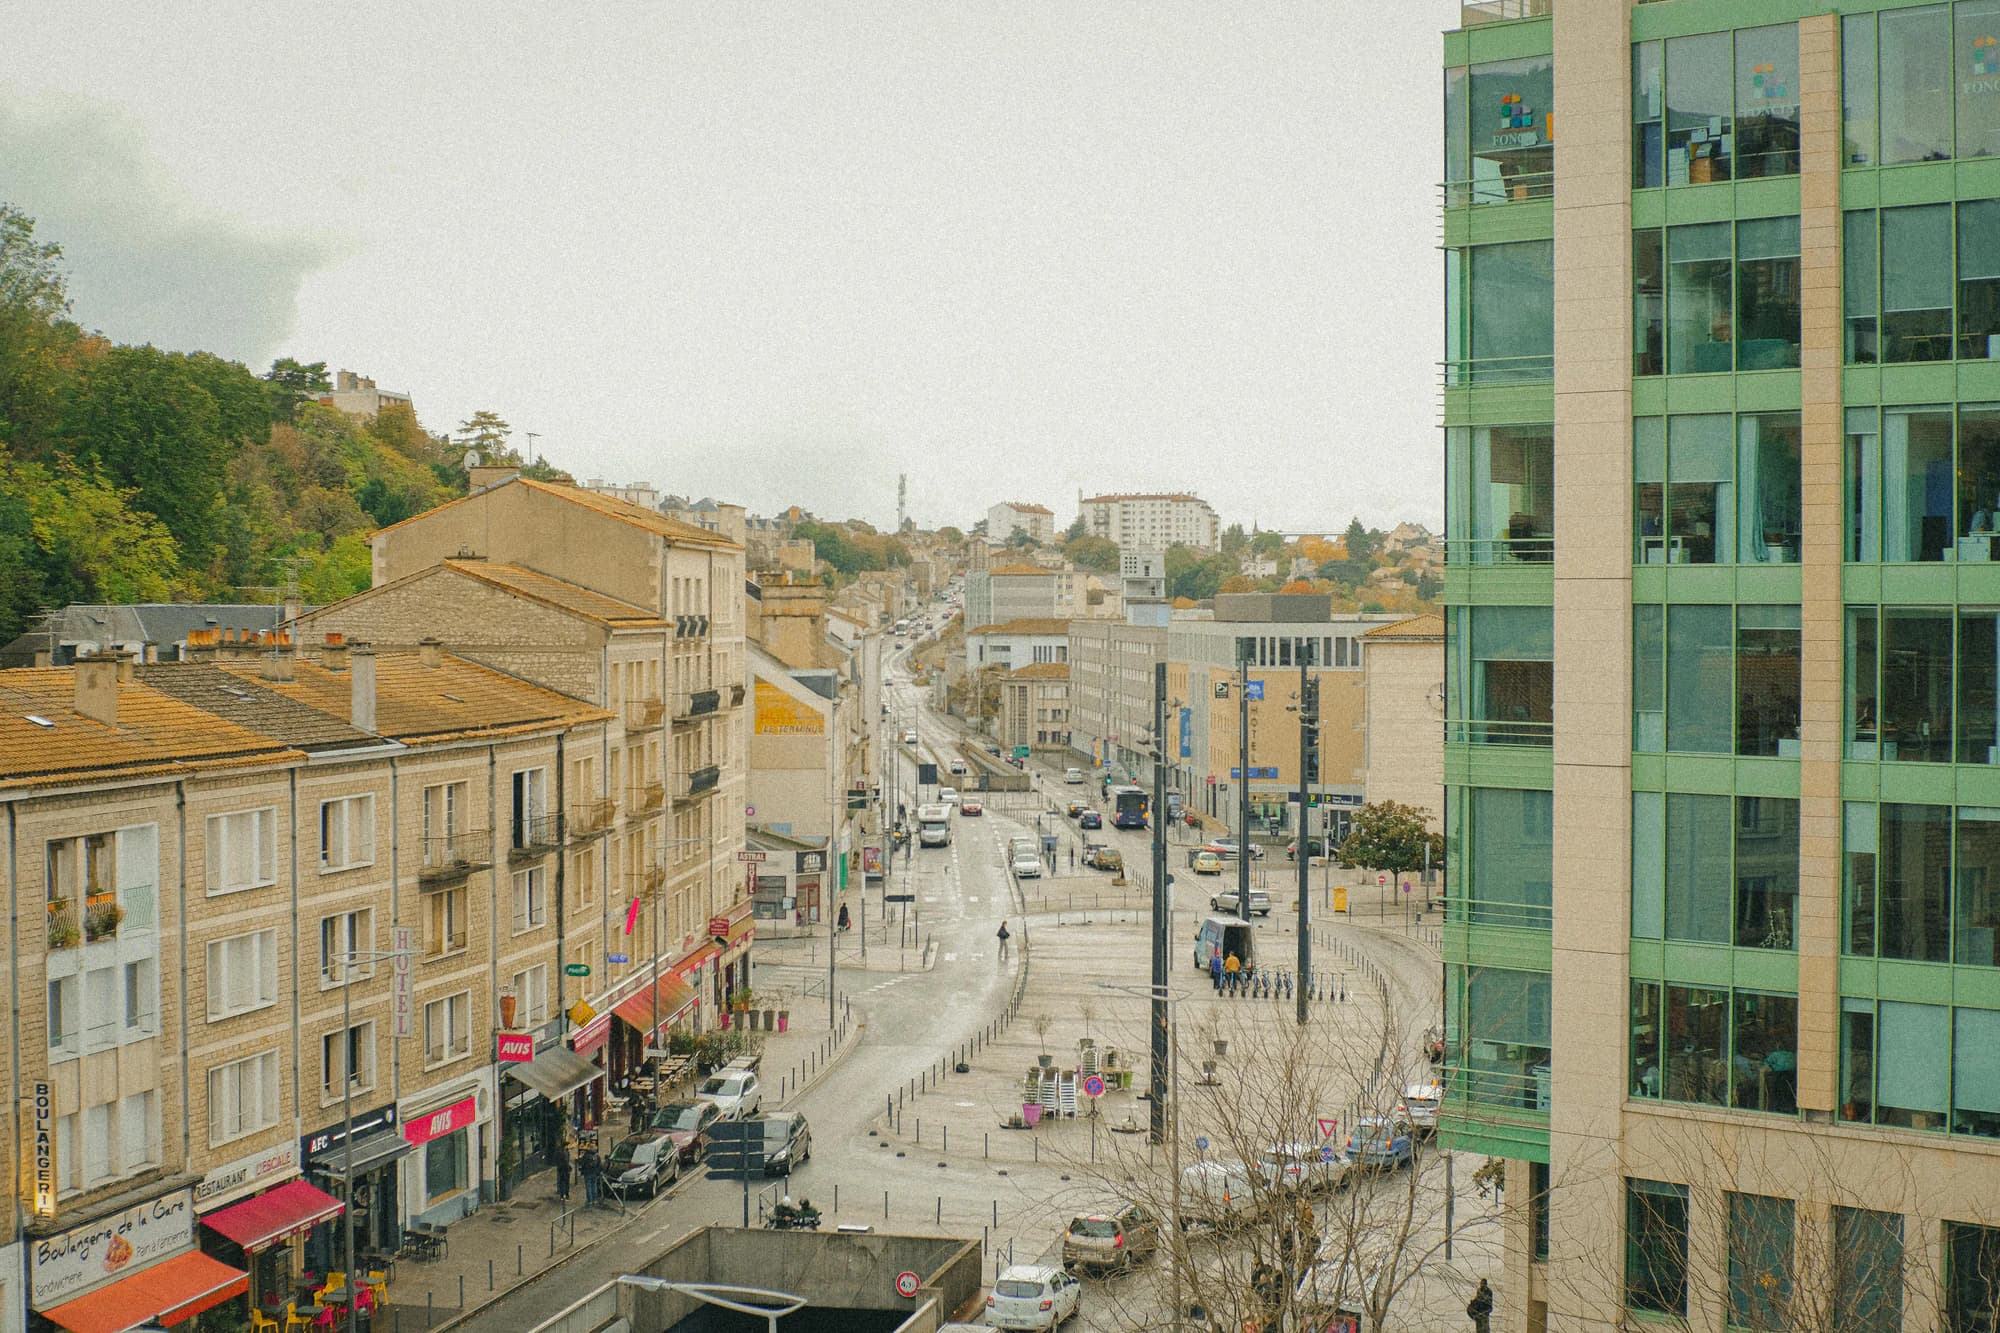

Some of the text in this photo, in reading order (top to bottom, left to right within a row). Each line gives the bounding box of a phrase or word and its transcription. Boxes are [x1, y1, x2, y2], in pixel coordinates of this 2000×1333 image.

[739, 852, 765, 861] ASTRAL
[396, 931, 408, 1035] HOTEL
[501, 1042, 531, 1055] AVIS
[429, 1110, 453, 1137] AVIS
[36, 1084, 50, 1218] BOULANGERIE
[309, 1135, 329, 1153] AFC
[196, 1168, 248, 1198] RESTAURANT
[38, 1199, 185, 1266] Boulangerie de la Gare
